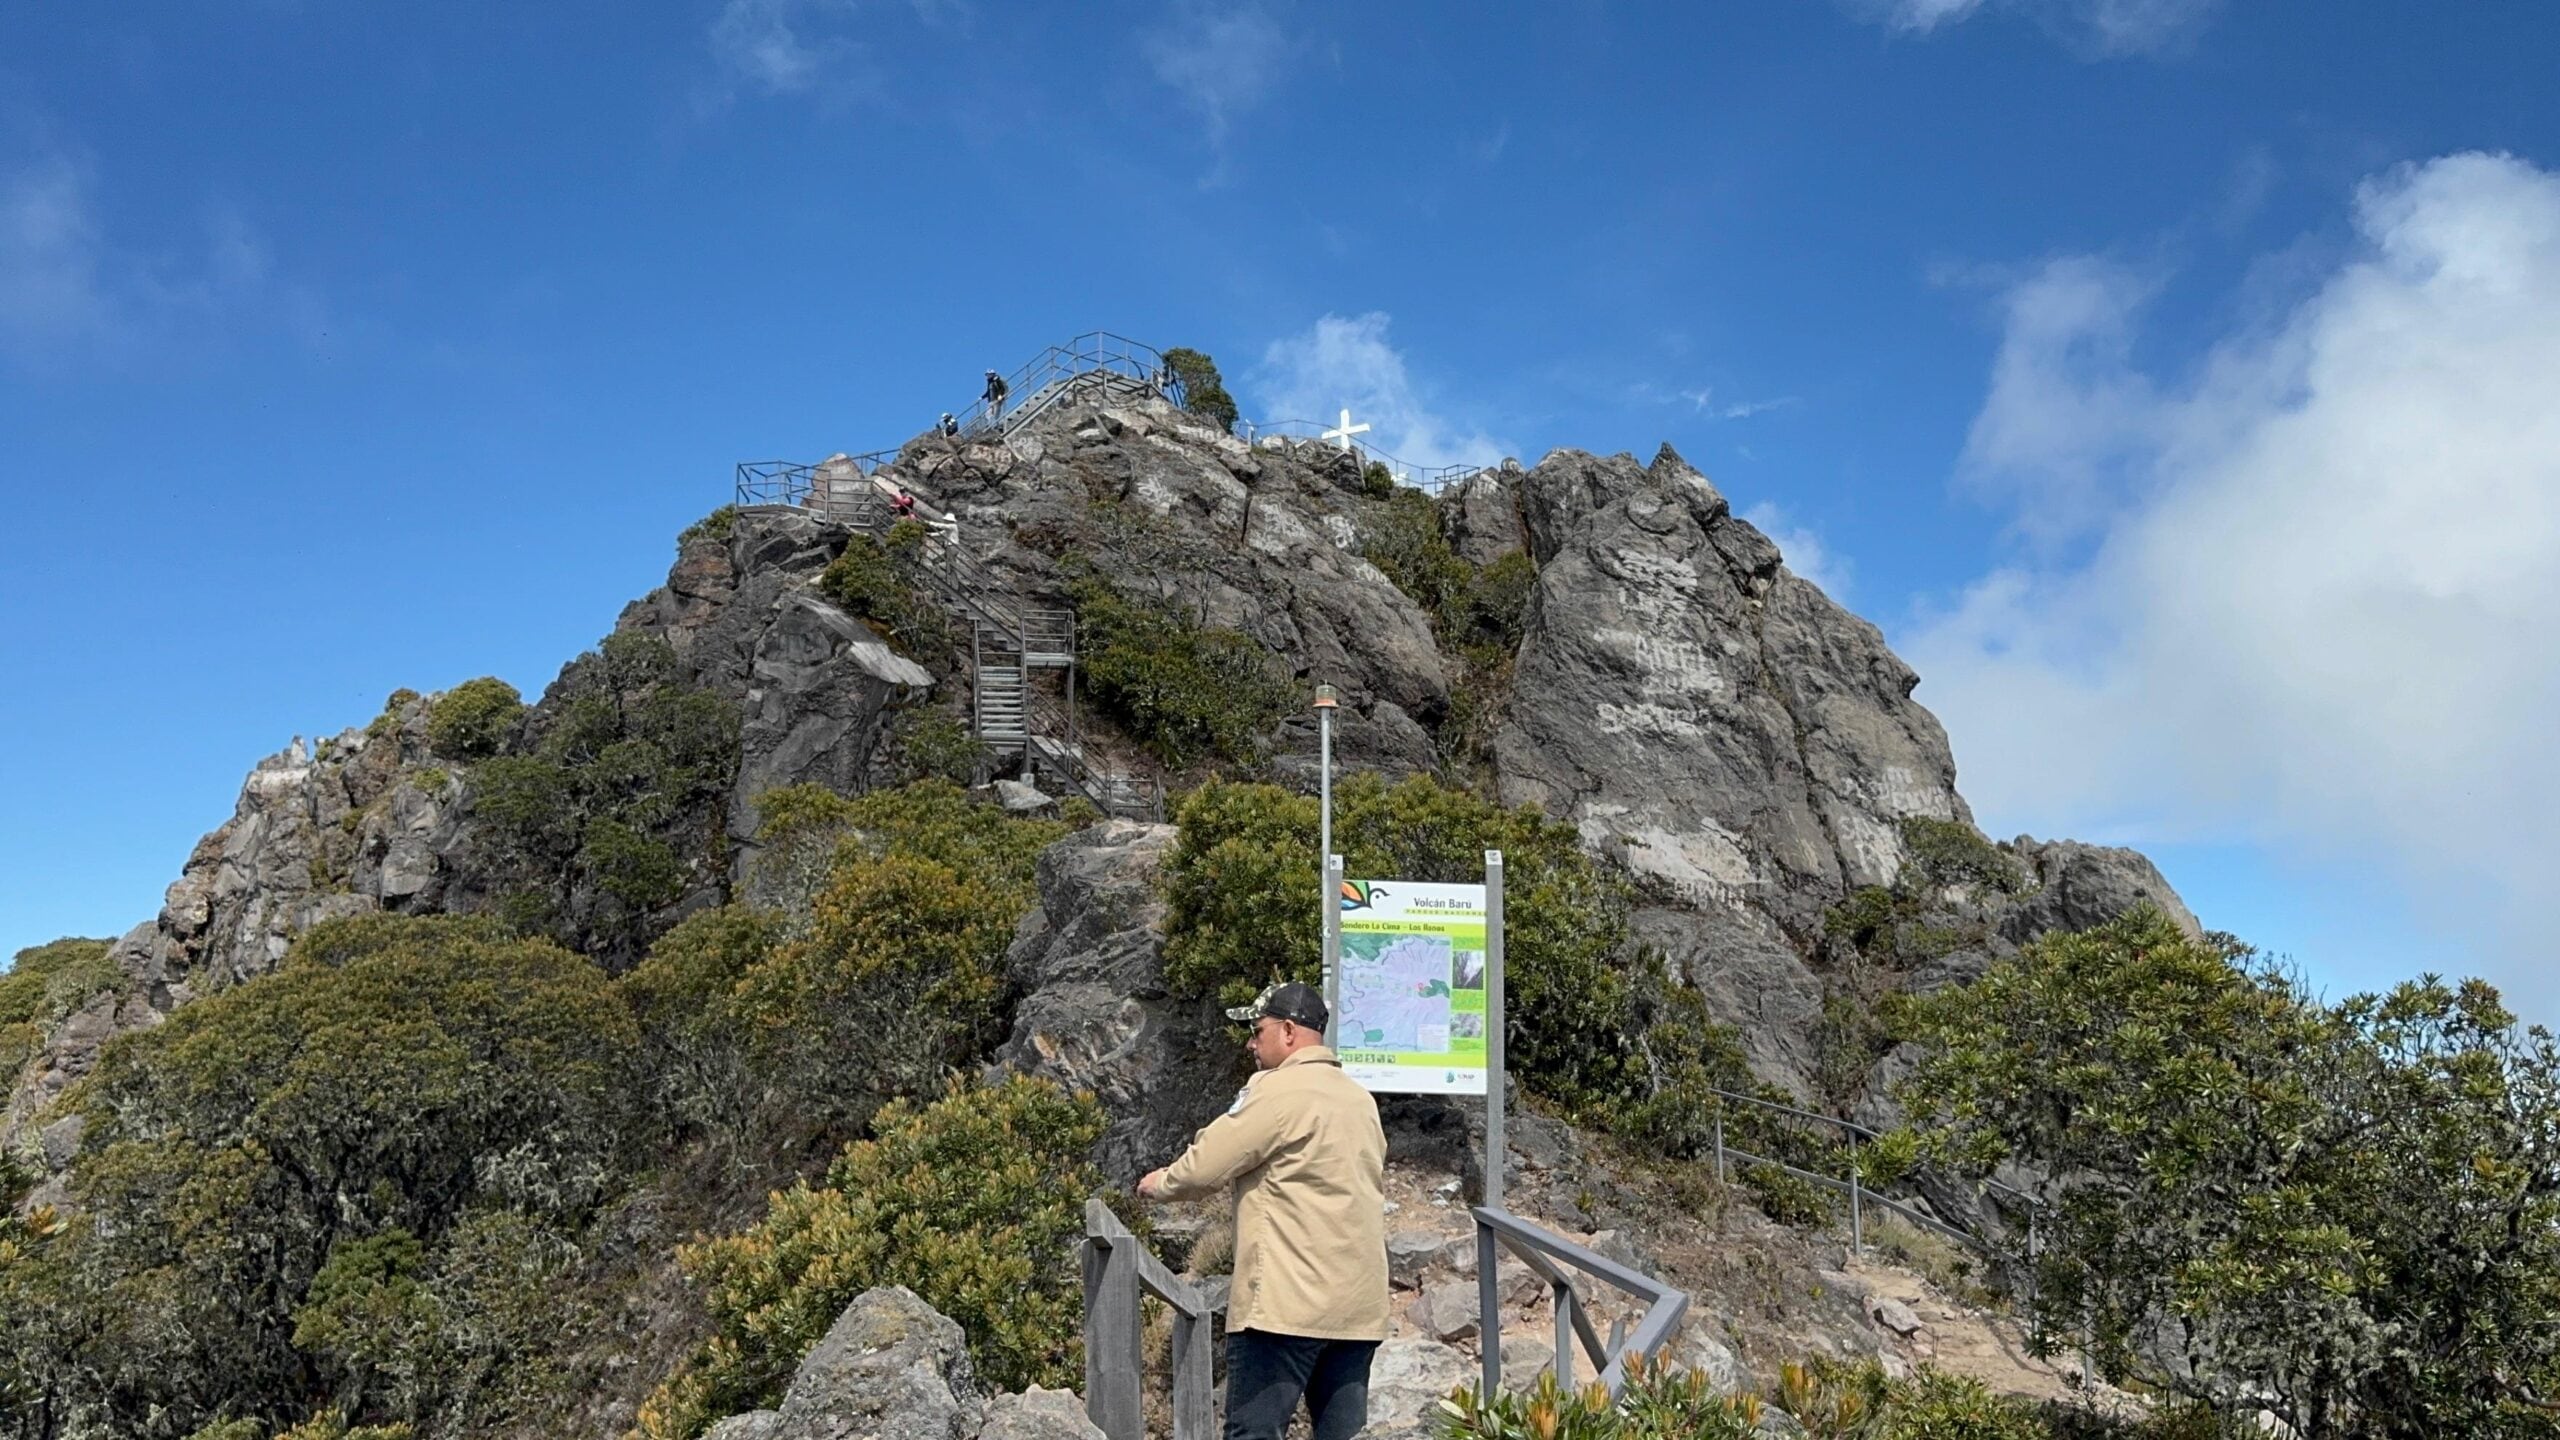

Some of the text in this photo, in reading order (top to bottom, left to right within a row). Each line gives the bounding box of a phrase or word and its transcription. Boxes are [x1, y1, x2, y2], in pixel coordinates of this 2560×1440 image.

[1413, 897, 1472, 909] Volcán Barú
[1371, 922, 1380, 930] La
[1409, 923, 1422, 931] Los
